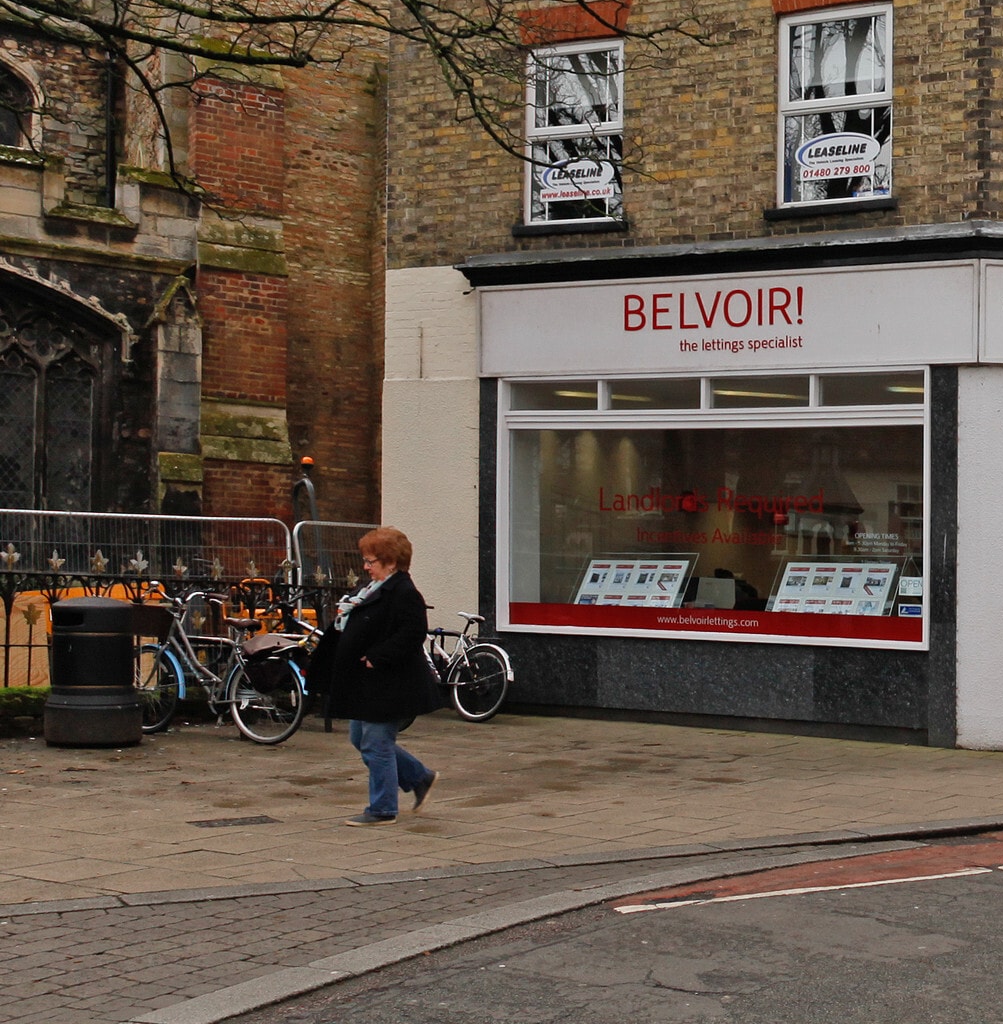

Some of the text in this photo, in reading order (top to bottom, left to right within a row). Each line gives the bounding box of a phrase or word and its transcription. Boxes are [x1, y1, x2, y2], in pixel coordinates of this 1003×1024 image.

[807, 143, 868, 159] LEASELINE
[803, 164, 871, 178] 01480 279 800
[623, 286, 804, 332] BELVOIR!
[679, 336, 803, 353] the lettings specialist
[599, 487, 824, 520] Landlords Required
[900, 579, 923, 588] OPEN
[657, 615, 759, 629] www.belvoirlettings.com
